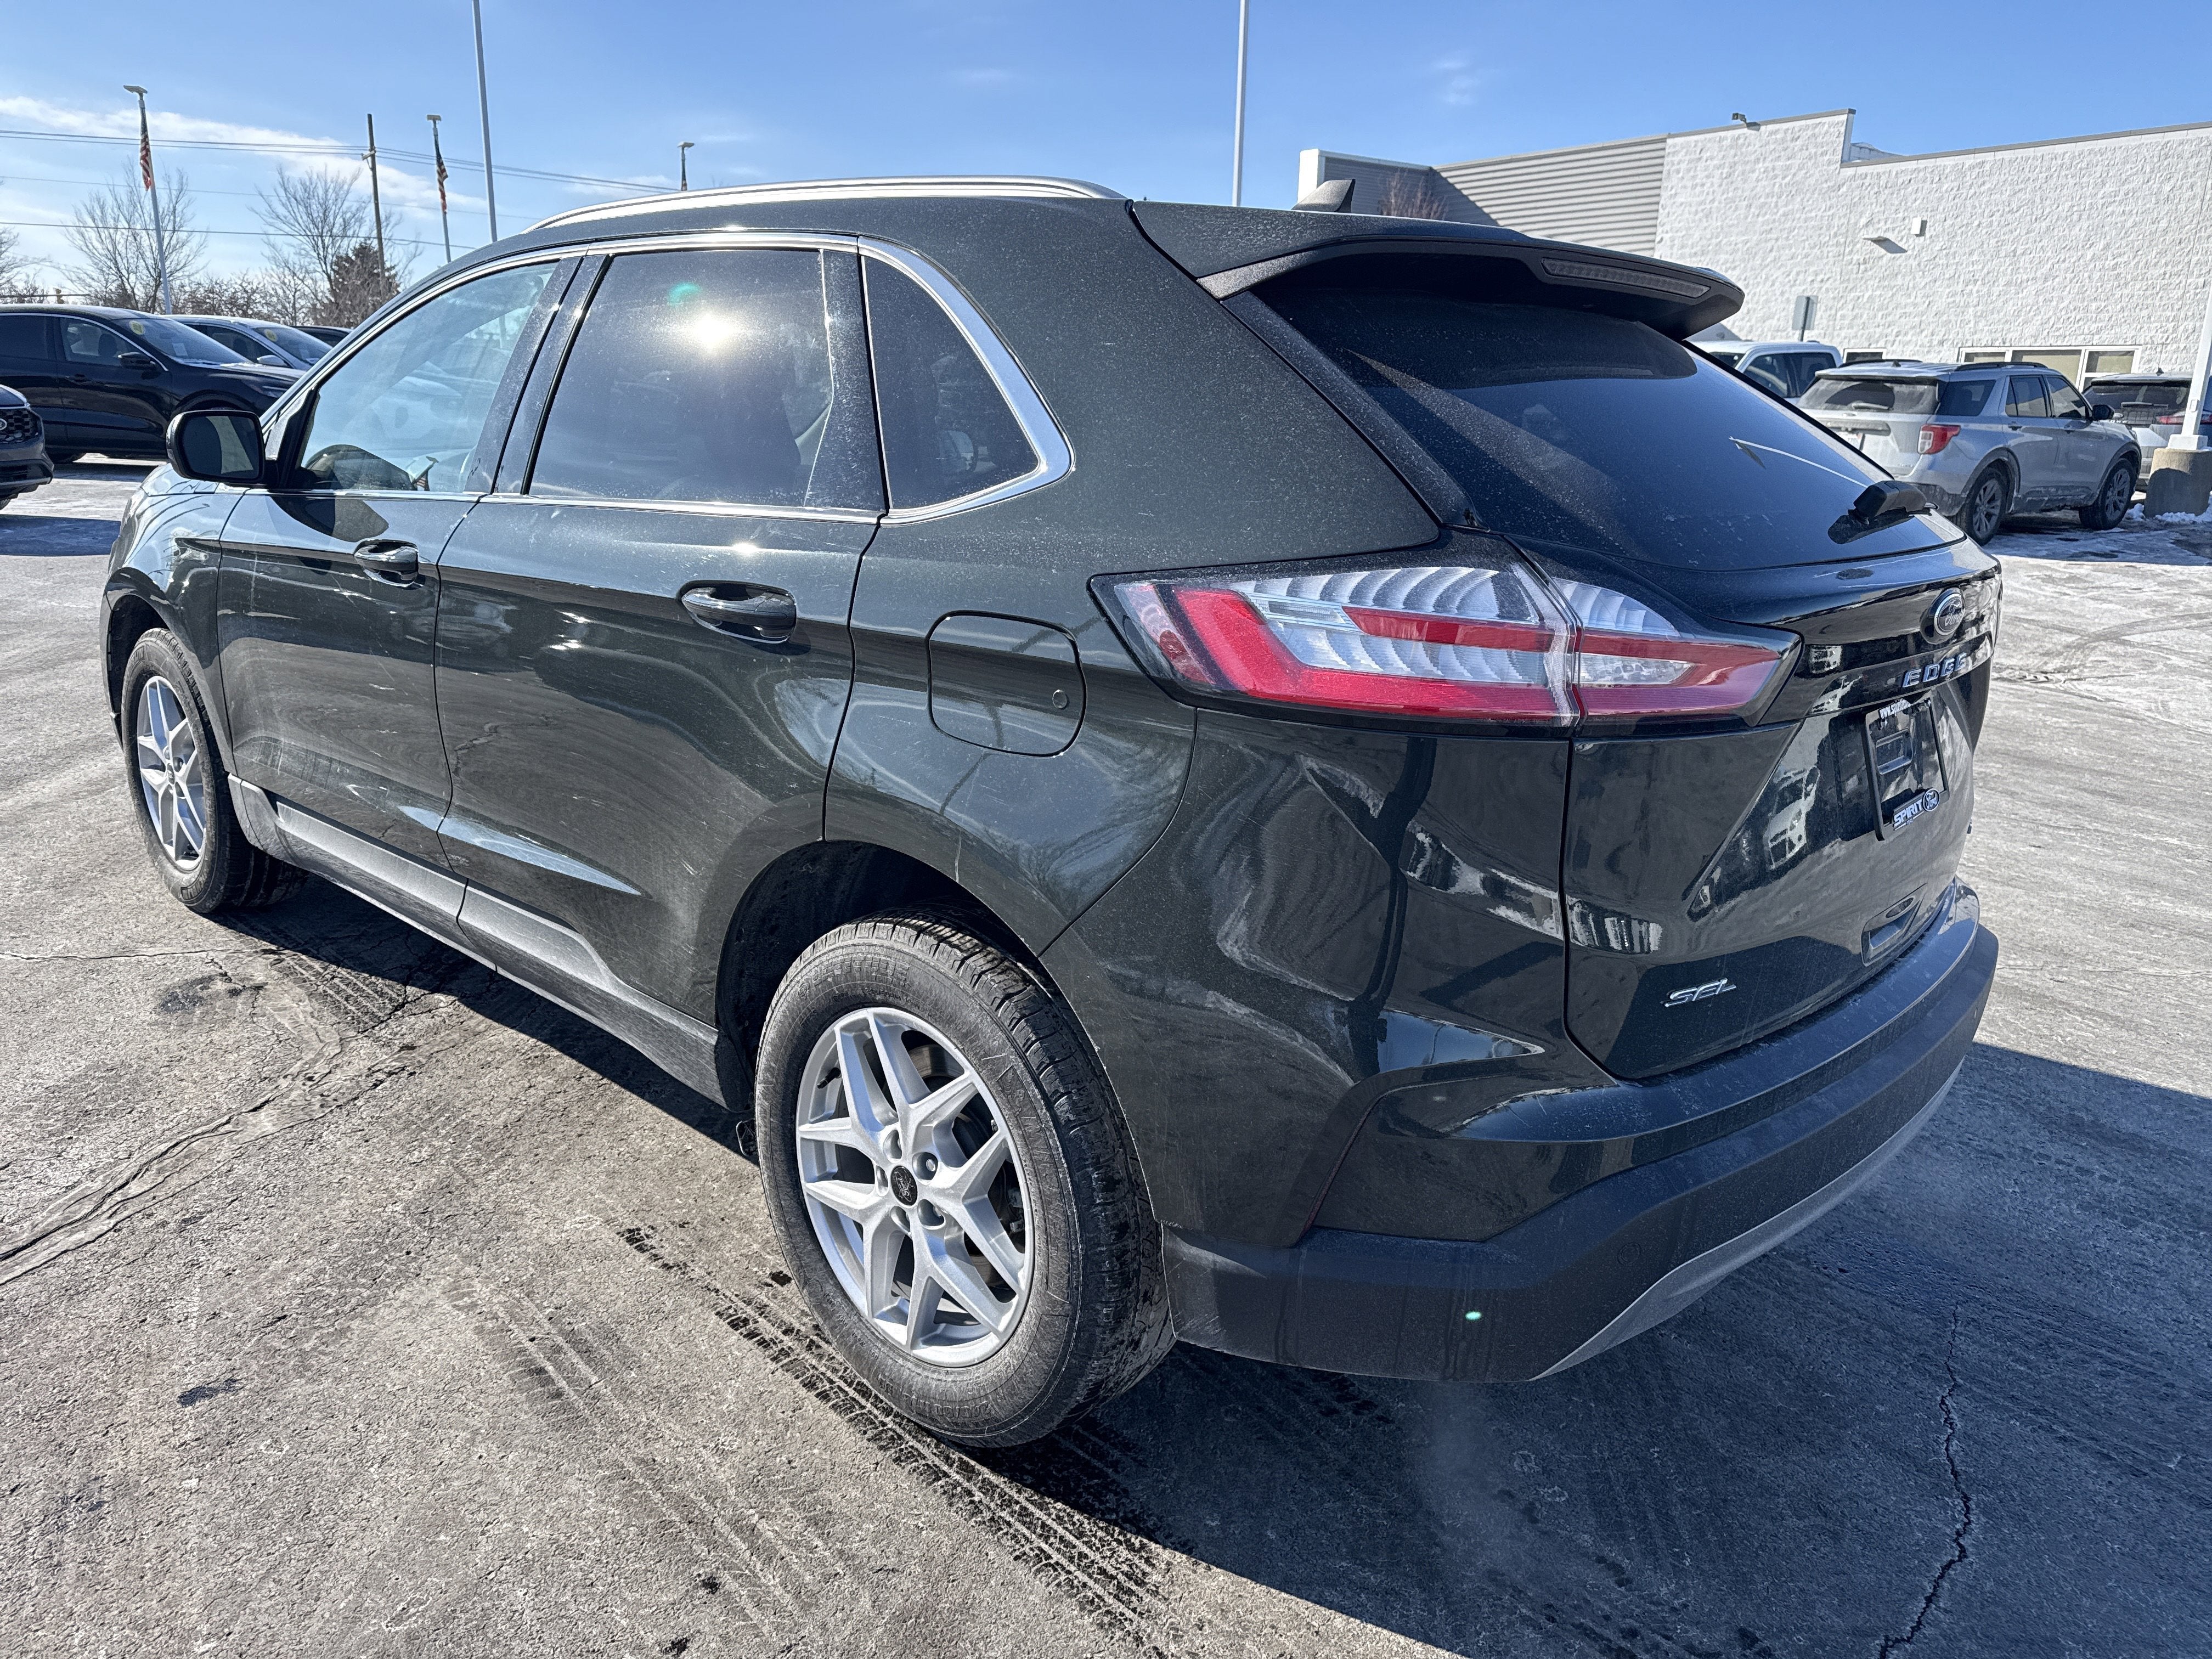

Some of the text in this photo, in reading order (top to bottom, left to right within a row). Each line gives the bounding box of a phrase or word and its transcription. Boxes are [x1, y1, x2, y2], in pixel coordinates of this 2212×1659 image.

[1902, 652, 1967, 688] EDGE
[1894, 799, 1922, 827] SPIRIT
[1663, 977, 1737, 1007] SEL
